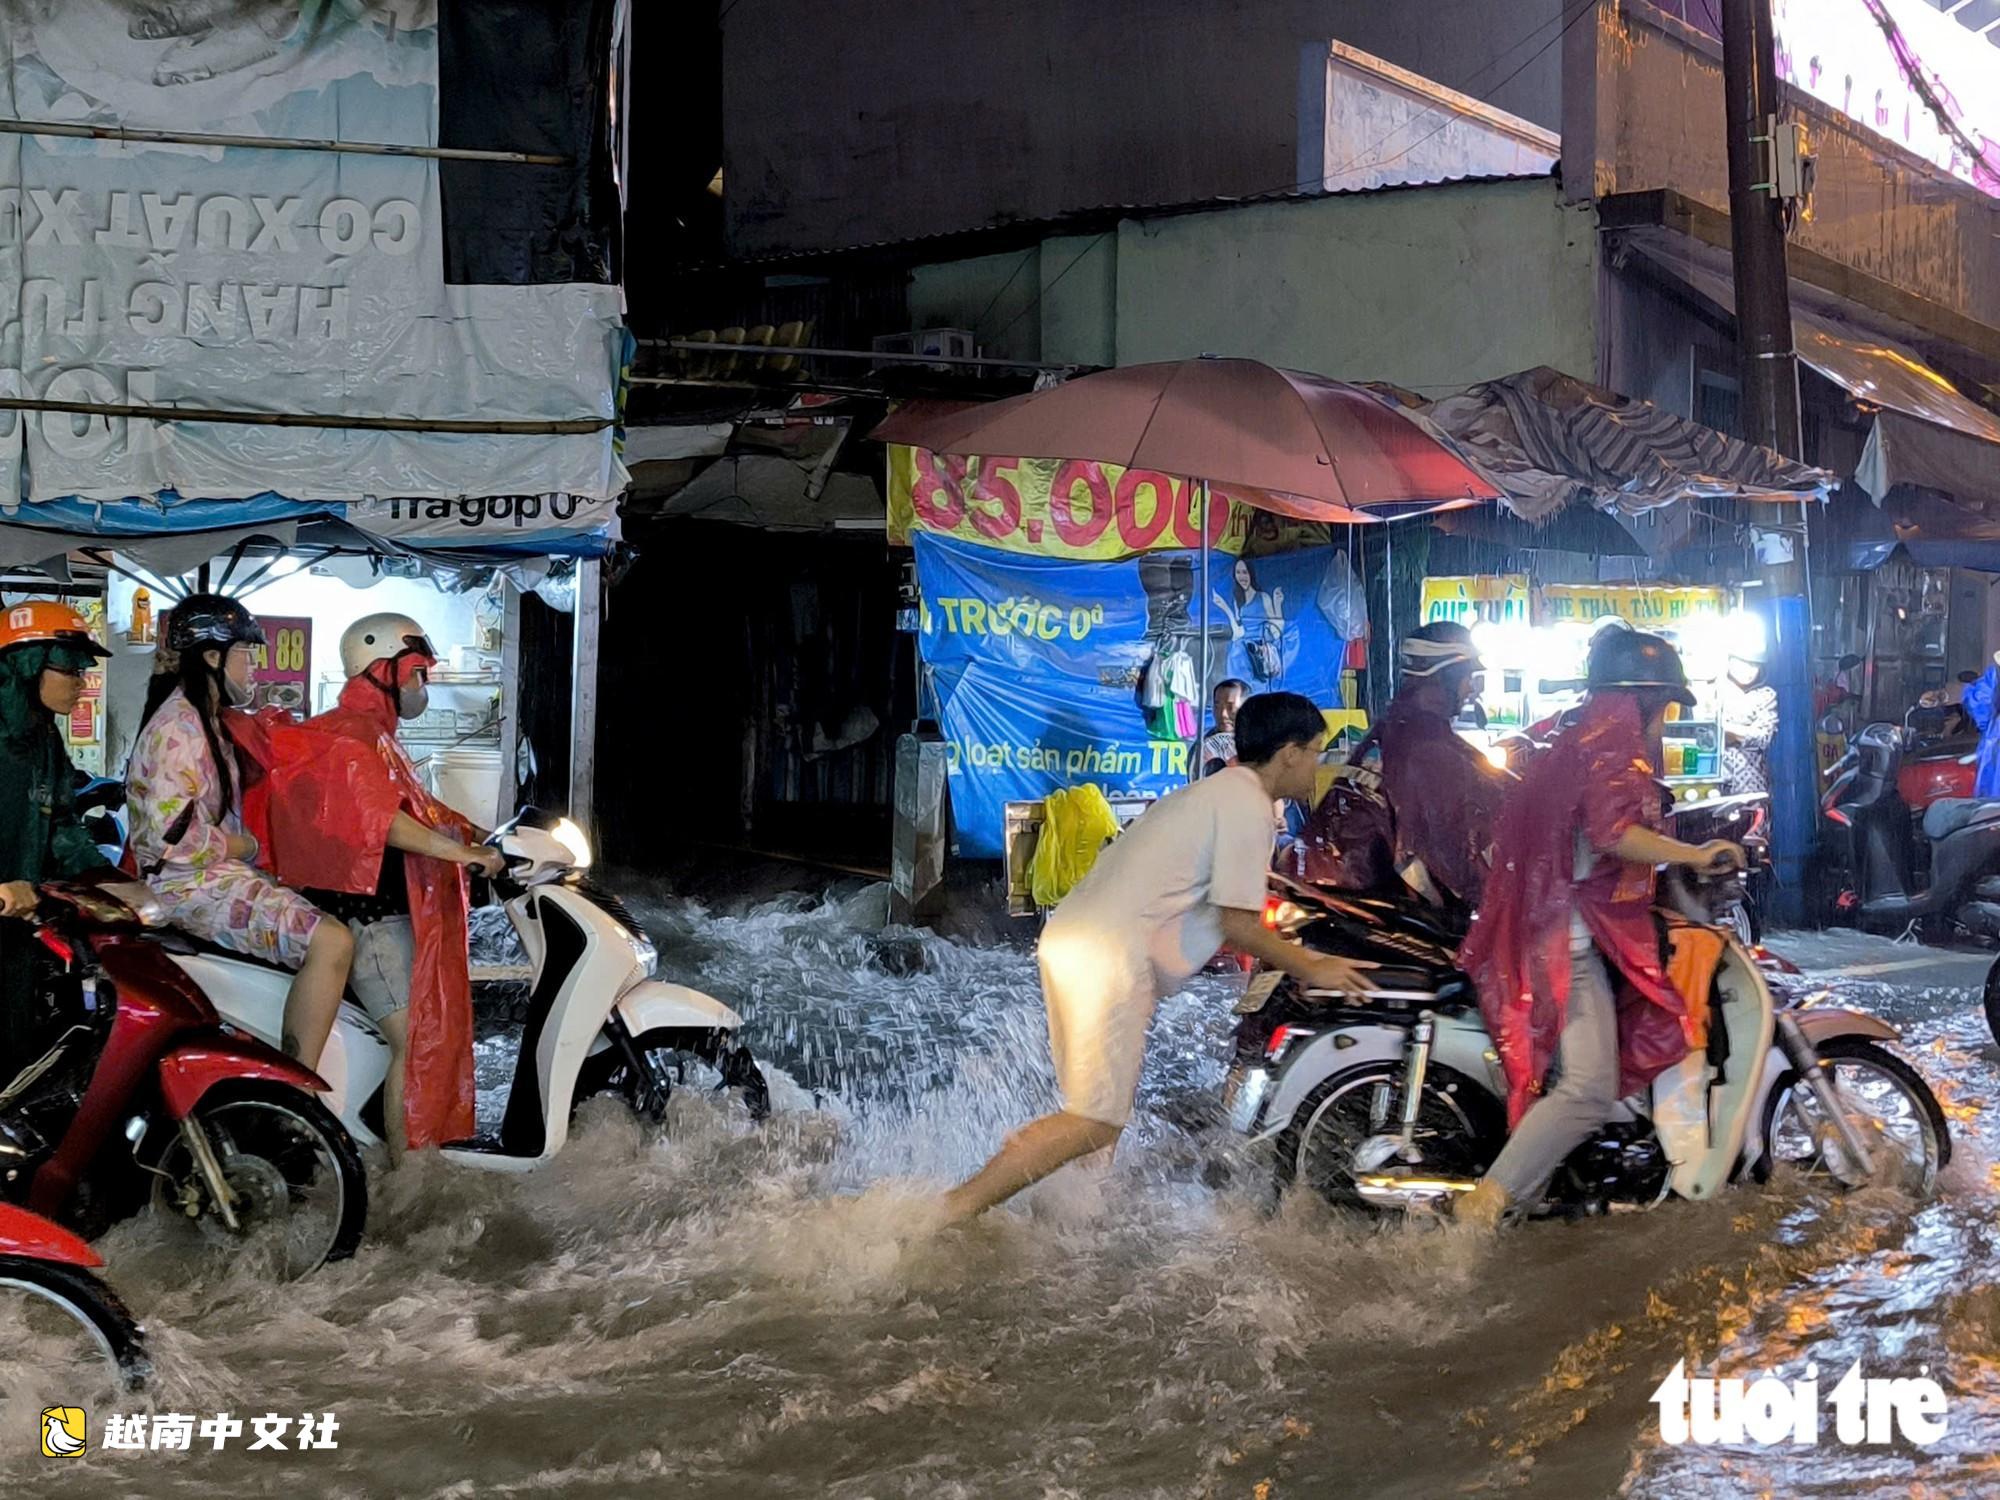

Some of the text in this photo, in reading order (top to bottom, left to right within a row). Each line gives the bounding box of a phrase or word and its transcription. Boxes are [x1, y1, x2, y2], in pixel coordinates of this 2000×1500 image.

[319, 198, 421, 264] CÓ
[912, 449, 1229, 547] 85.000
[937, 596, 1063, 640] TRƯỚC
[276, 628, 305, 671] 88
[1017, 737, 1060, 771] sản
[1066, 742, 1141, 778] phẩm
